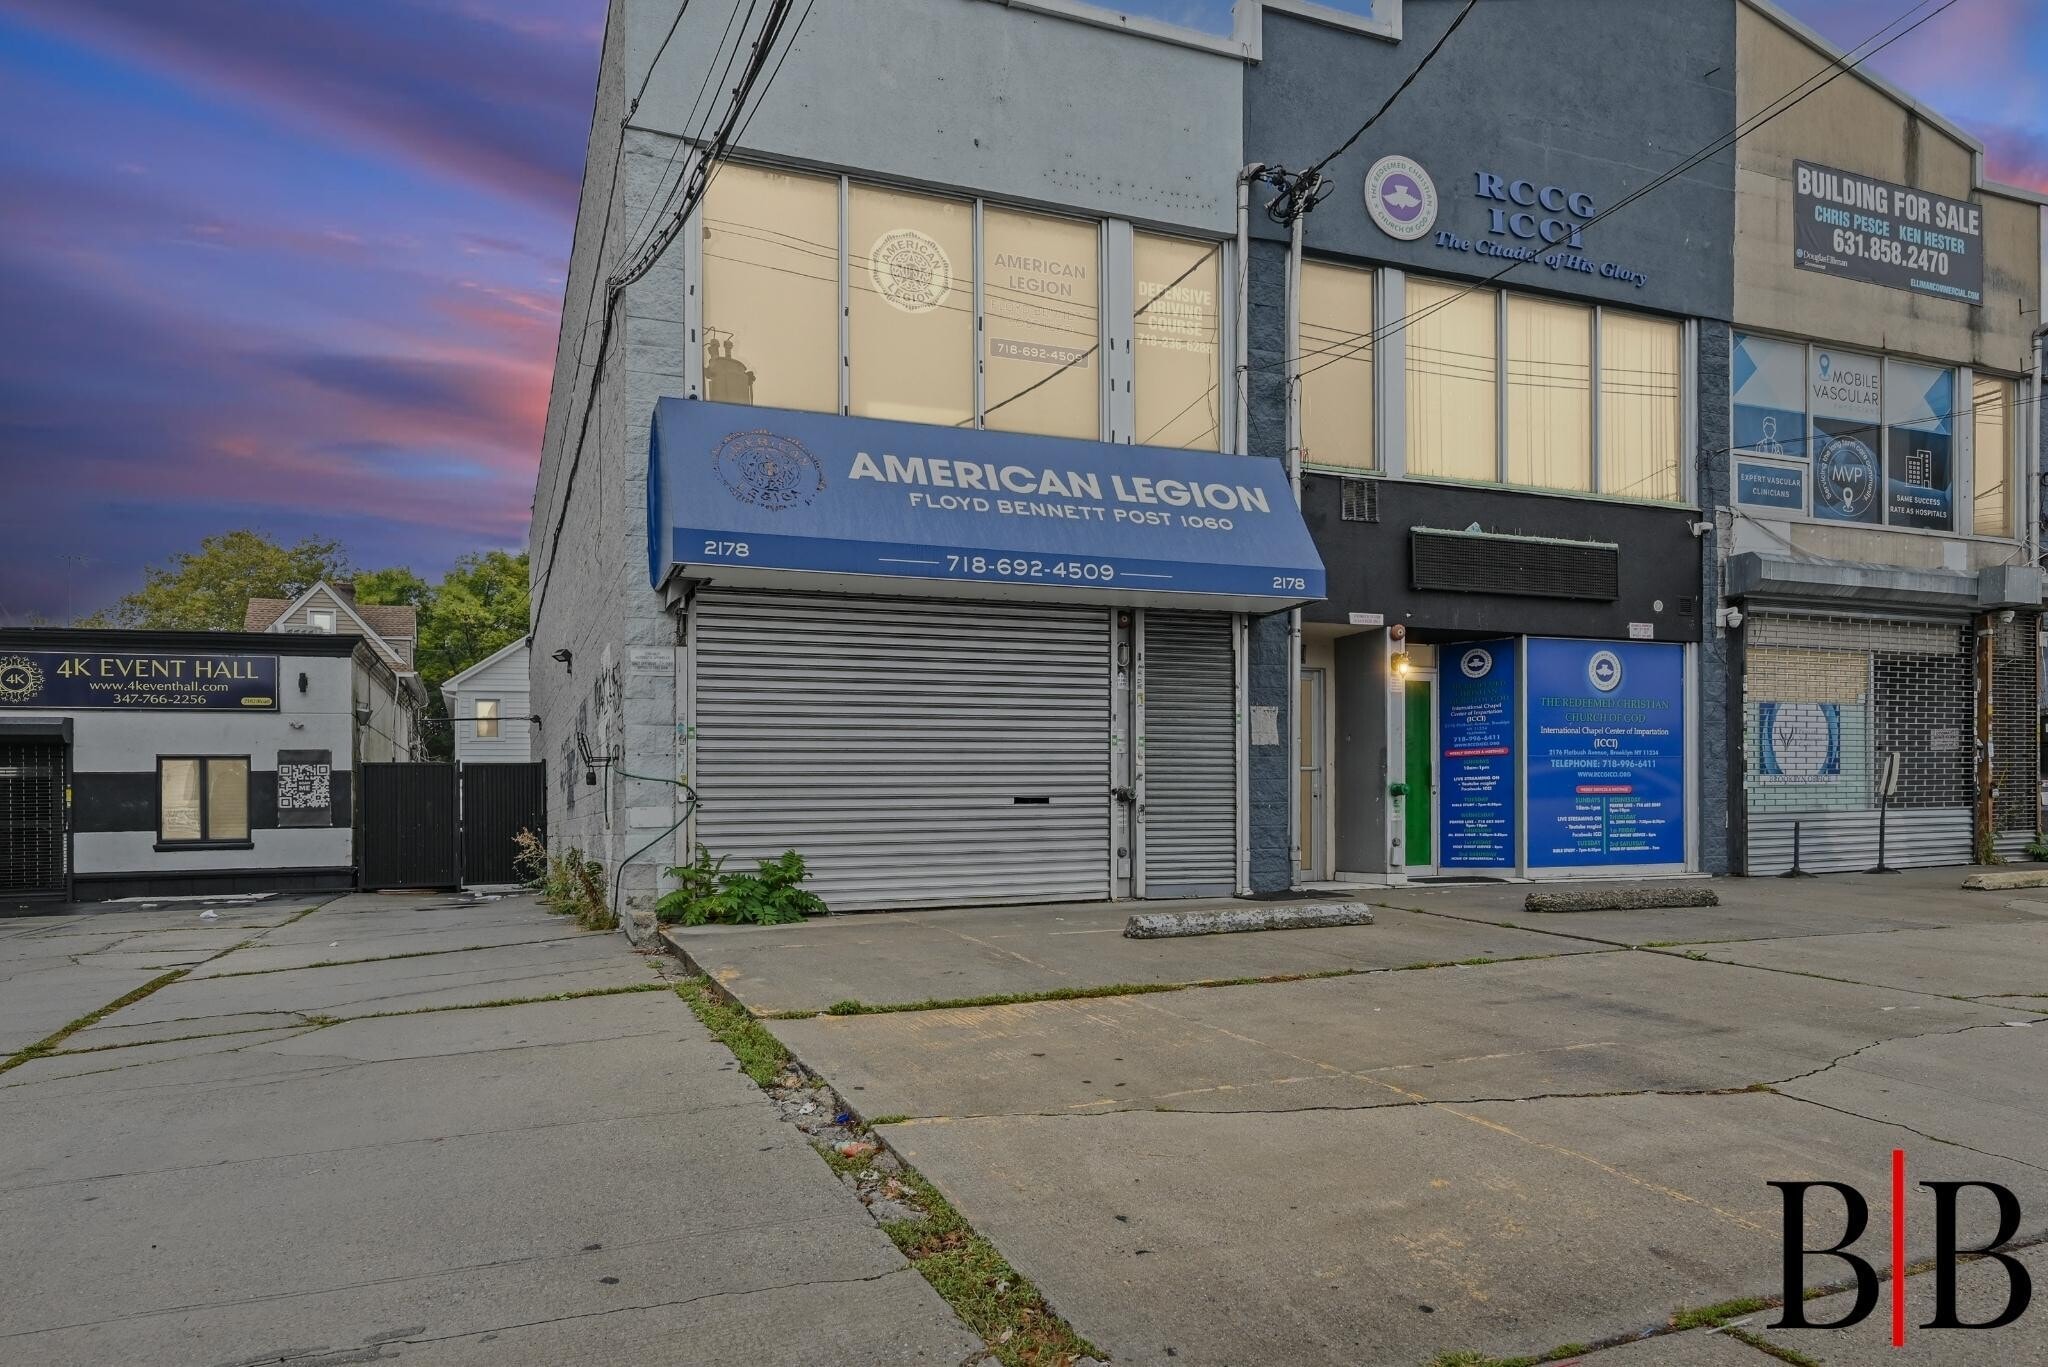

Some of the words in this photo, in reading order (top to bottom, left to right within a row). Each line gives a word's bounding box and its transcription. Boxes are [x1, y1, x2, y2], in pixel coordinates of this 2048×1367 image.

[1475, 170, 1596, 218] RCCG
[1797, 166, 1888, 214] BUILDING
[1894, 190, 1930, 224] FOR
[1935, 201, 1980, 236] SALE
[1378, 211, 1404, 232] CHURCH
[1415, 216, 1428, 231] GOD
[1488, 207, 1584, 250] ICCI
[1814, 205, 1850, 228] CHRIS
[1853, 214, 1890, 238] PESCE
[1899, 224, 1922, 245] KEN
[1924, 230, 1965, 254] HESTER
[882, 240, 941, 269] AMERICAN
[1435, 230, 1470, 250] The
[1475, 239, 1543, 264] Citadel
[1545, 252, 1566, 270] of
[1564, 254, 1595, 274] His
[1600, 262, 1648, 289] Glory
[1833, 228, 1949, 276] 631.858.2470
[994, 253, 1087, 280] AMERICAN
[888, 282, 934, 302] LEGION
[1009, 275, 1072, 296] LEGION
[1138, 280, 1212, 306] DEFENSIVE
[1148, 316, 1203, 336] COURSE
[1832, 370, 1878, 389] MOBILE
[1812, 383, 1879, 406] VASCULAR
[1829, 440, 1842, 452] long
[1842, 440, 1856, 448] term
[1823, 450, 1831, 462] the
[848, 452, 1103, 500] AMERICAN
[1112, 474, 1270, 514] LEGION
[1740, 473, 1766, 484] EXPERT
[1766, 476, 1800, 488] VASCULAR
[1820, 463, 1832, 500] Serving
[1832, 464, 1862, 484] MVP
[1865, 460, 1873, 501] community
[1752, 487, 1790, 498] CLINICIANS
[1896, 494, 1913, 503] SAME
[1914, 496, 1940, 506] SUCCESS
[910, 493, 990, 512] FLOYD
[998, 500, 1105, 522] BENNETT
[1114, 508, 1172, 526] POST
[1180, 515, 1234, 531] 1060
[1890, 506, 1904, 514] RATE
[1916, 508, 1947, 518] HOSPITALS
[704, 540, 750, 558] 2178
[946, 555, 1114, 582] 718-692-4509
[1272, 576, 1306, 590] 2178
[6, 674, 24, 684] 4K
[56, 659, 92, 678] 4K
[100, 659, 188, 678] EVENT
[196, 660, 258, 680] HALL
[90, 681, 228, 692] www.4keventhall.com
[113, 694, 206, 705] 347-766-2256
[1542, 697, 1560, 707] THE
[1562, 698, 1616, 708] REDEEMED
[1616, 698, 1670, 709] CHRISTIAN
[1565, 712, 1608, 722] CHURCH
[1609, 714, 1620, 722] OF
[1624, 714, 1646, 723] GOD
[1540, 726, 1580, 734] International
[1582, 726, 1604, 736] Chapel
[1604, 726, 1626, 736] Center
[1626, 727, 1634, 735] of
[1634, 728, 1669, 736] Impartation
[1594, 738, 1618, 750] (ICCI)
[1551, 760, 1600, 768] TELEPHONE:
[1602, 760, 1656, 768] 718-996-6411
